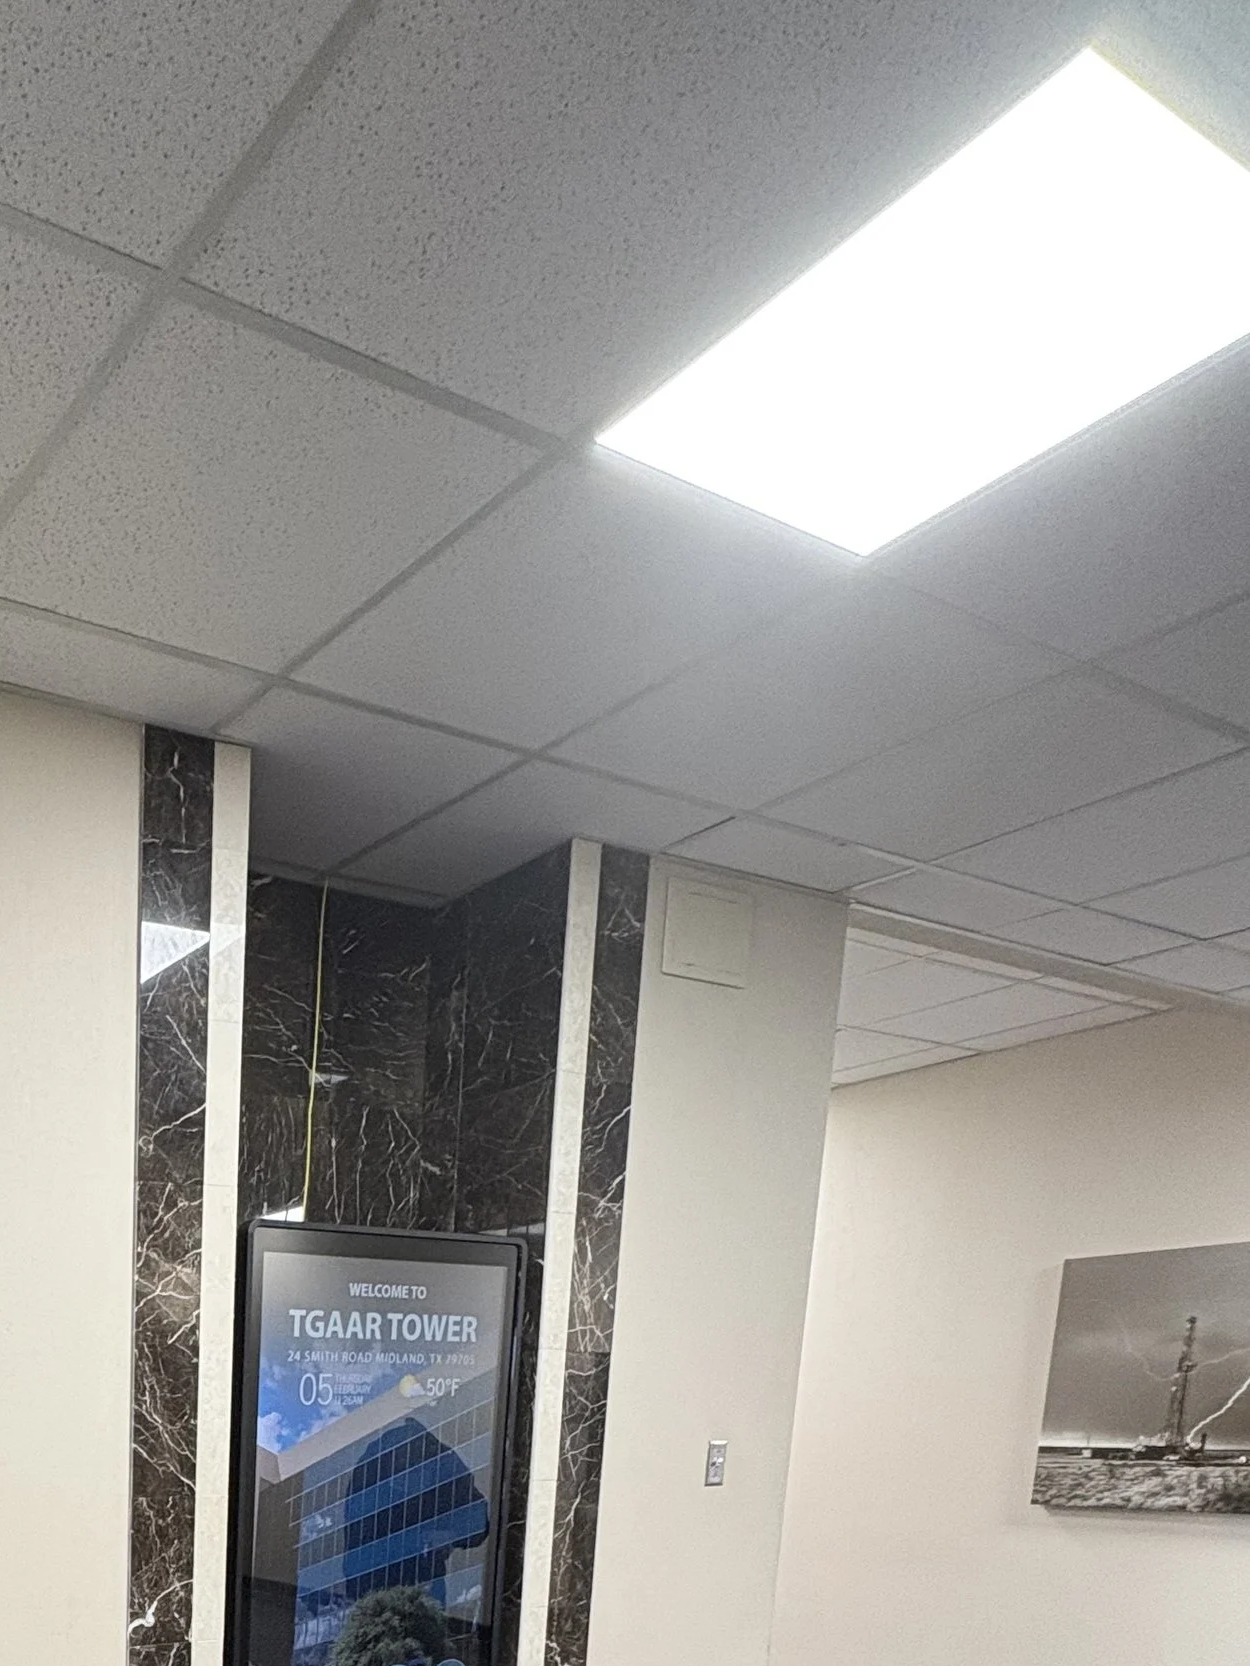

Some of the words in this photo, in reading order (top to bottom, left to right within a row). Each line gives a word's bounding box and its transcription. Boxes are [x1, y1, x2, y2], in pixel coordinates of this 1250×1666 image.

[350, 1283, 409, 1299] WELCOME
[411, 1286, 426, 1299] TO
[289, 1309, 381, 1340] TGAAR
[387, 1313, 477, 1342] TOWER
[287, 1350, 300, 1362] 24
[305, 1352, 337, 1362] SMITH
[342, 1352, 372, 1363] ROAD
[376, 1353, 426, 1365] MIDLAND,
[430, 1354, 442, 1364] TX
[301, 1373, 333, 1406] 05
[427, 1378, 460, 1396] 50°F
